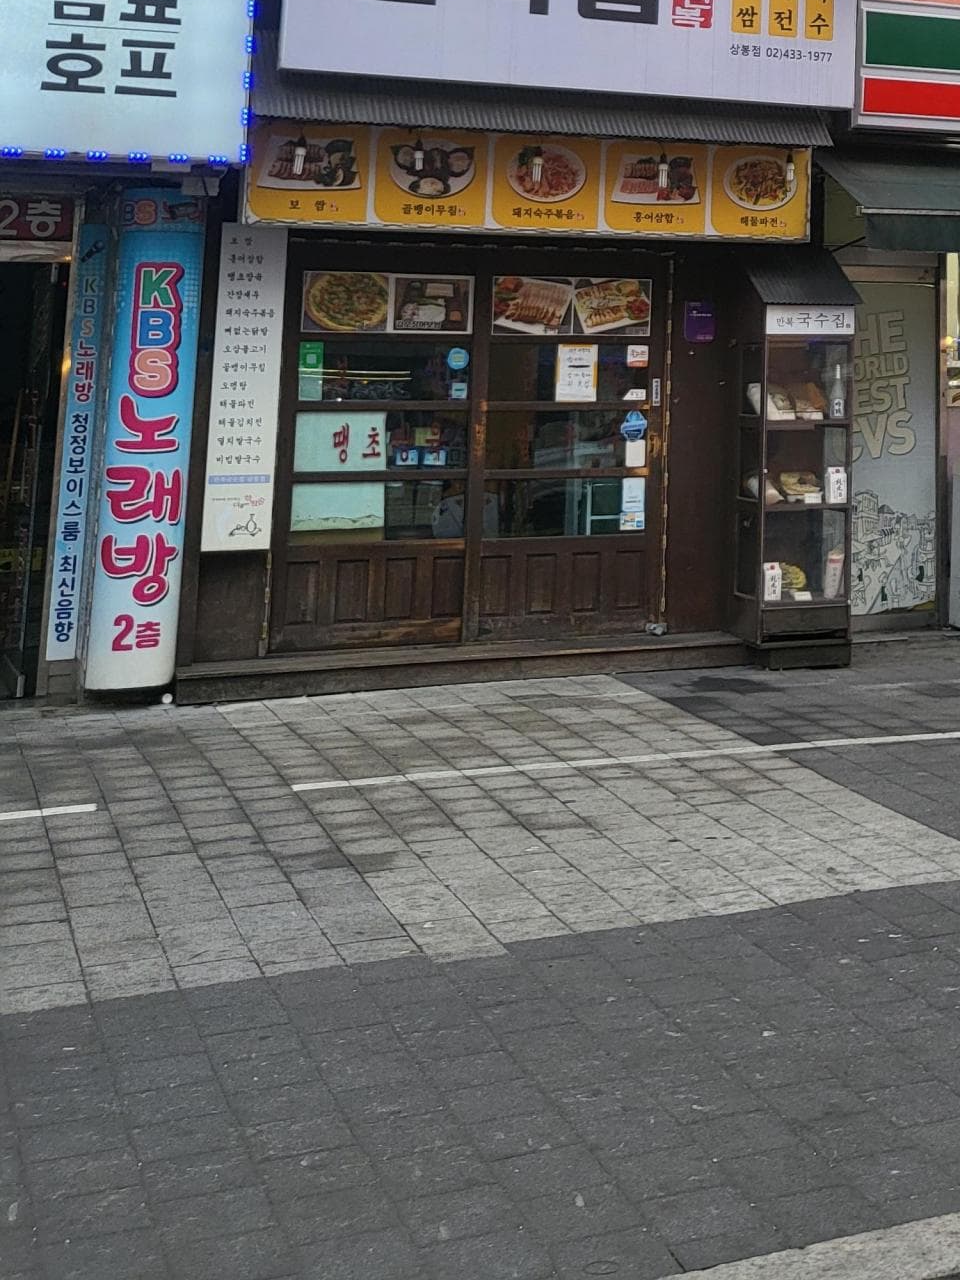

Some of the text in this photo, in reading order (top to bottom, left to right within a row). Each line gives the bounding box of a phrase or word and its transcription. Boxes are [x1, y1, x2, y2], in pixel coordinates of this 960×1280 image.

[41, 33, 177, 97] 호프
[730, 43, 832, 62] 상봉점 02)433-1977
[0, 199, 62, 237] 2층
[81, 276, 97, 337] KBS
[797, 312, 845, 328] 국수집
[854, 310, 907, 358] HE
[74, 340, 96, 404] 노래방
[854, 353, 909, 381] ORLD
[853, 376, 910, 415] EST
[101, 267, 181, 652] KBS 노래방 2층
